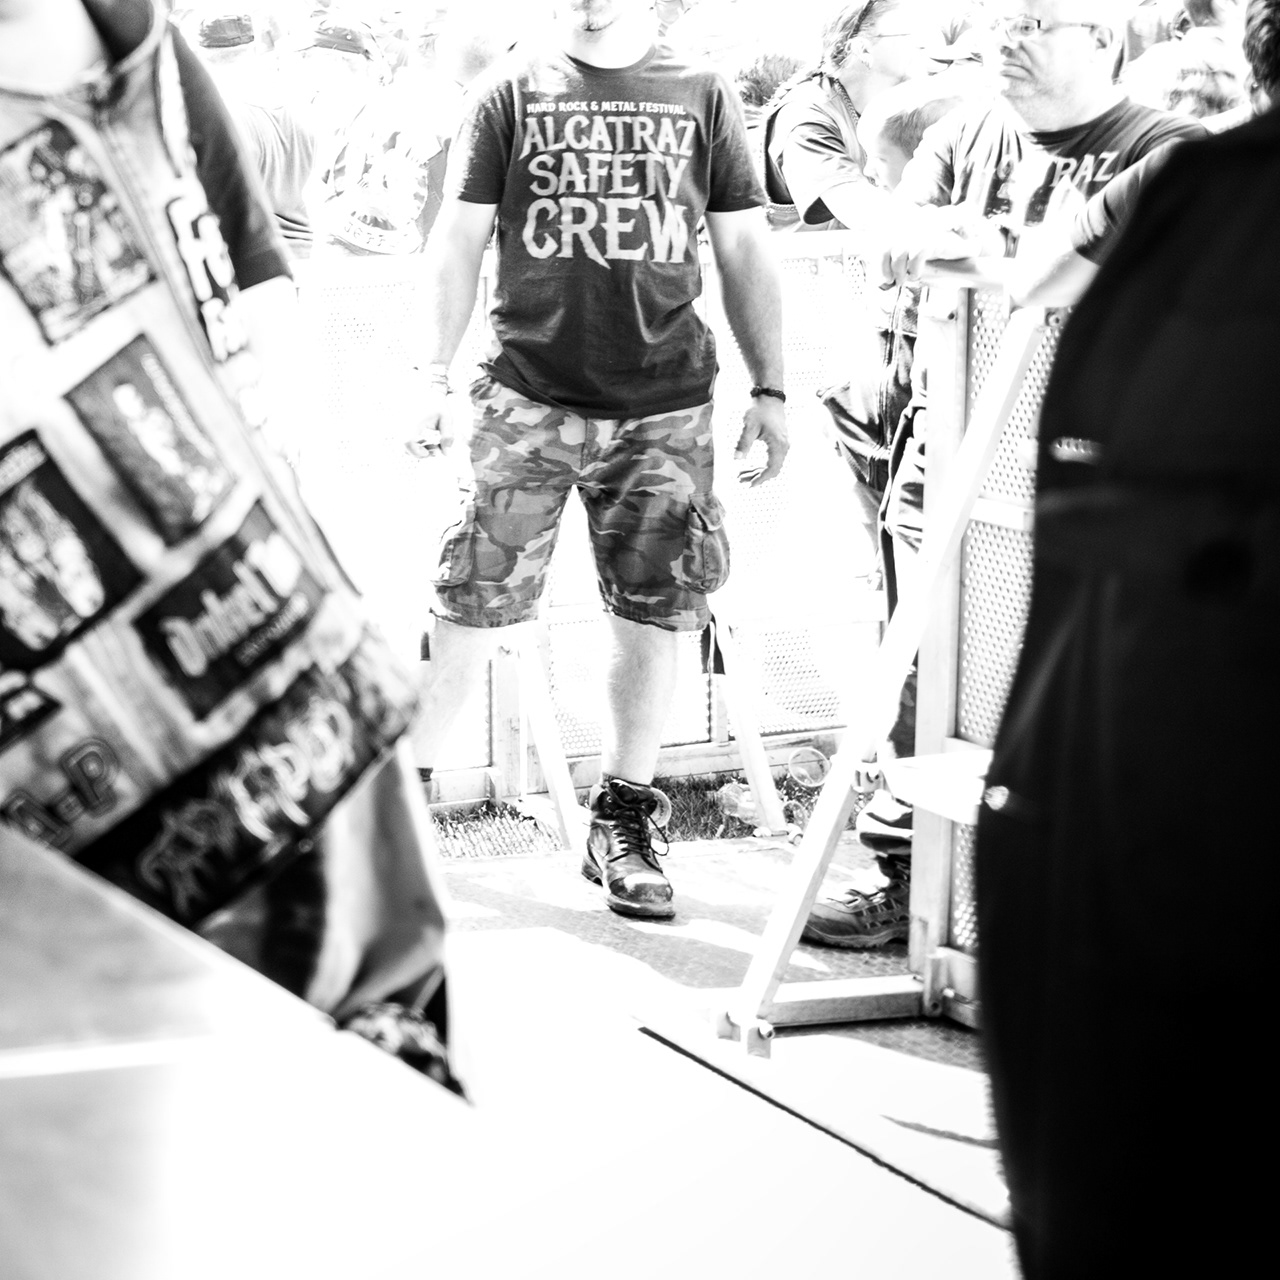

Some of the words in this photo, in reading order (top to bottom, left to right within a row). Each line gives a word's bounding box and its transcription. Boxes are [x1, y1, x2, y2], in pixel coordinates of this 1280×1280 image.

[526, 102, 556, 114] HARD
[558, 101, 589, 113] ROCK
[590, 101, 598, 112] &
[600, 101, 637, 113] METAL
[639, 101, 687, 116] FESTIVAL
[518, 114, 697, 165] ALCATRAZ
[527, 151, 690, 199] SAFETY
[522, 197, 689, 270] CREW
